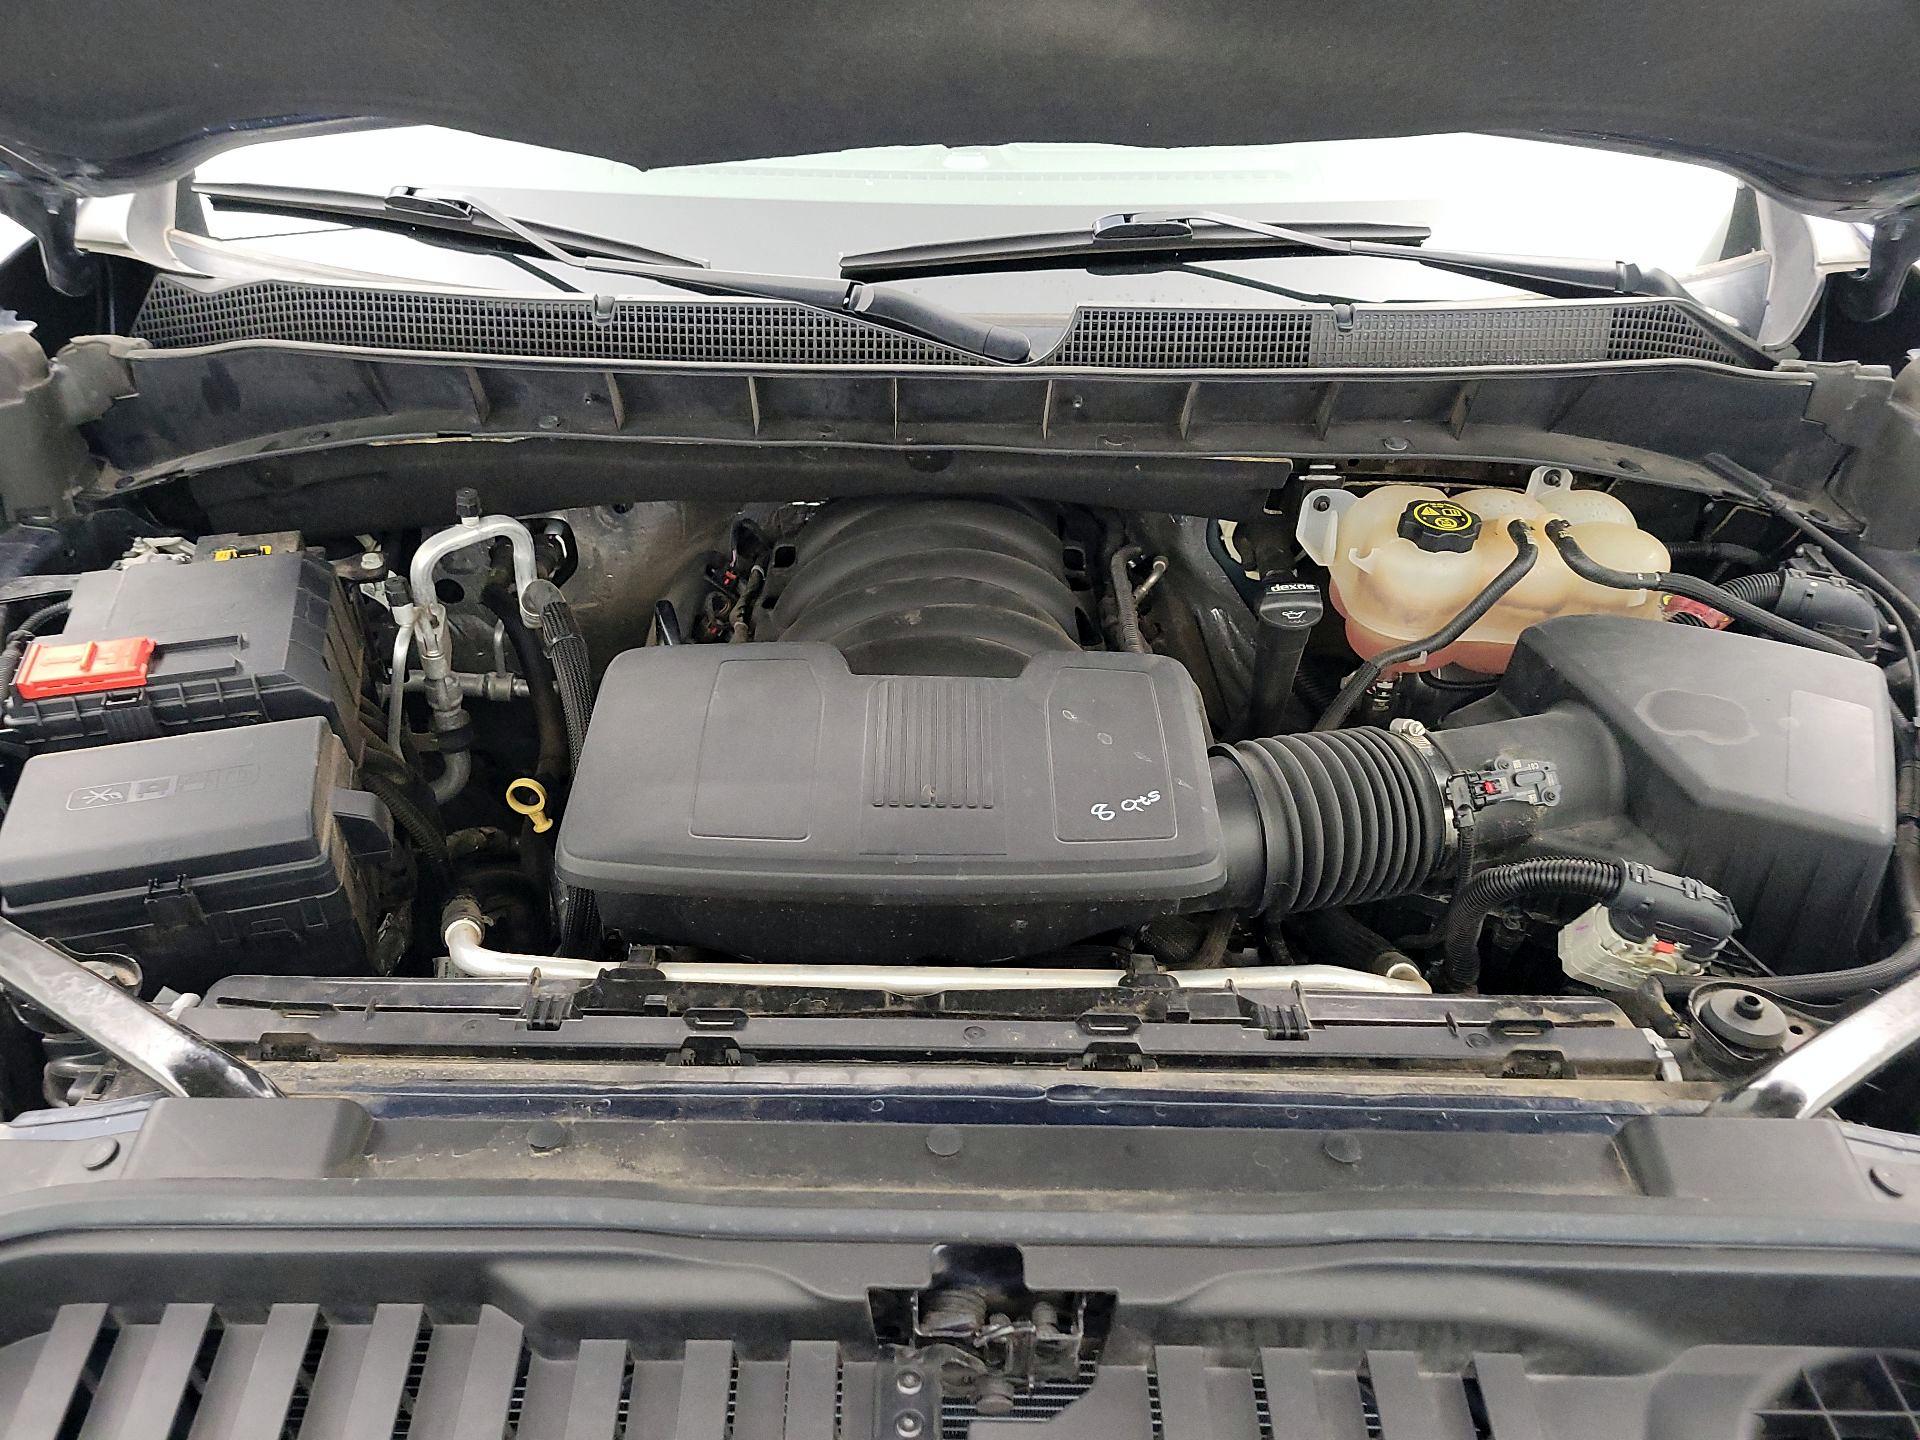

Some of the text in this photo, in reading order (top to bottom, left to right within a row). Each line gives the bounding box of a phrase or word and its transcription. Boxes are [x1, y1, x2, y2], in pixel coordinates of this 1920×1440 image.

[1270, 583, 1316, 592] dexos
[1090, 790, 1161, 821] 8 Qts
